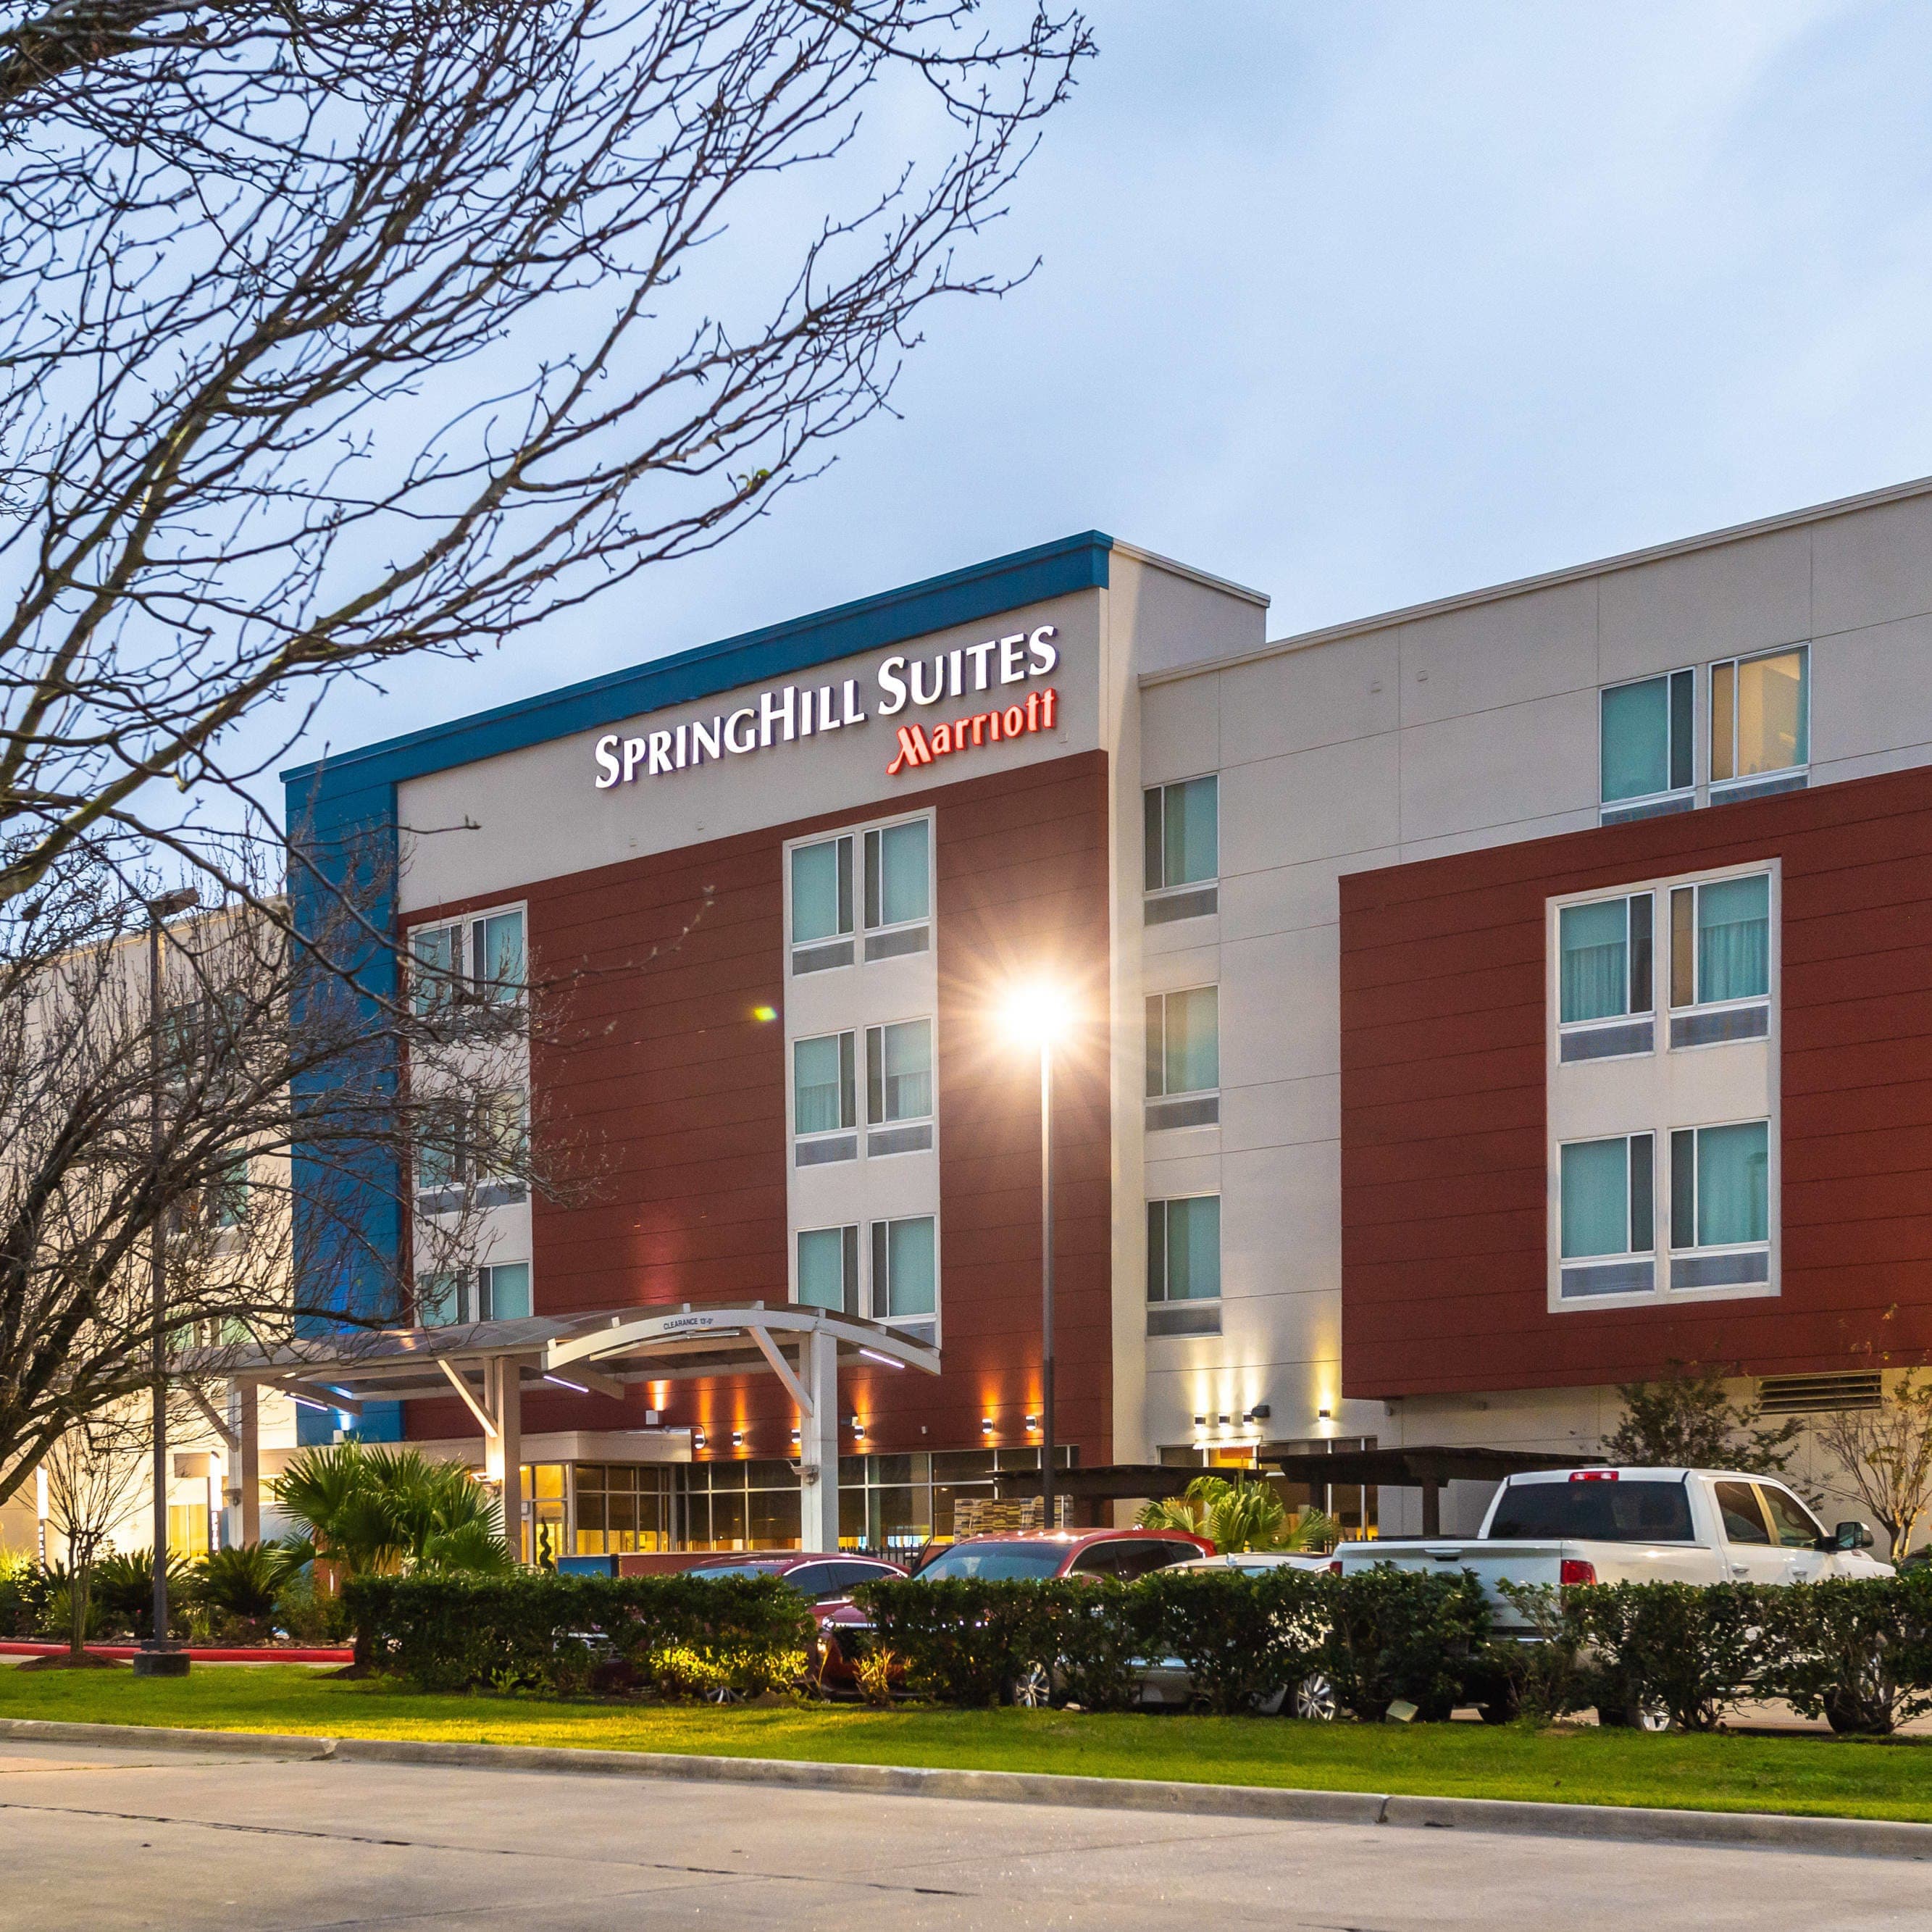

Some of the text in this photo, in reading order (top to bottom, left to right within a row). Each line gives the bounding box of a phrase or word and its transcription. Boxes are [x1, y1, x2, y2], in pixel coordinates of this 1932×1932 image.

[595, 625, 1059, 790] SPRINGHILL SUITES
[886, 687, 1056, 776] Marriott
[664, 1318, 698, 1330] CLEARANCE
